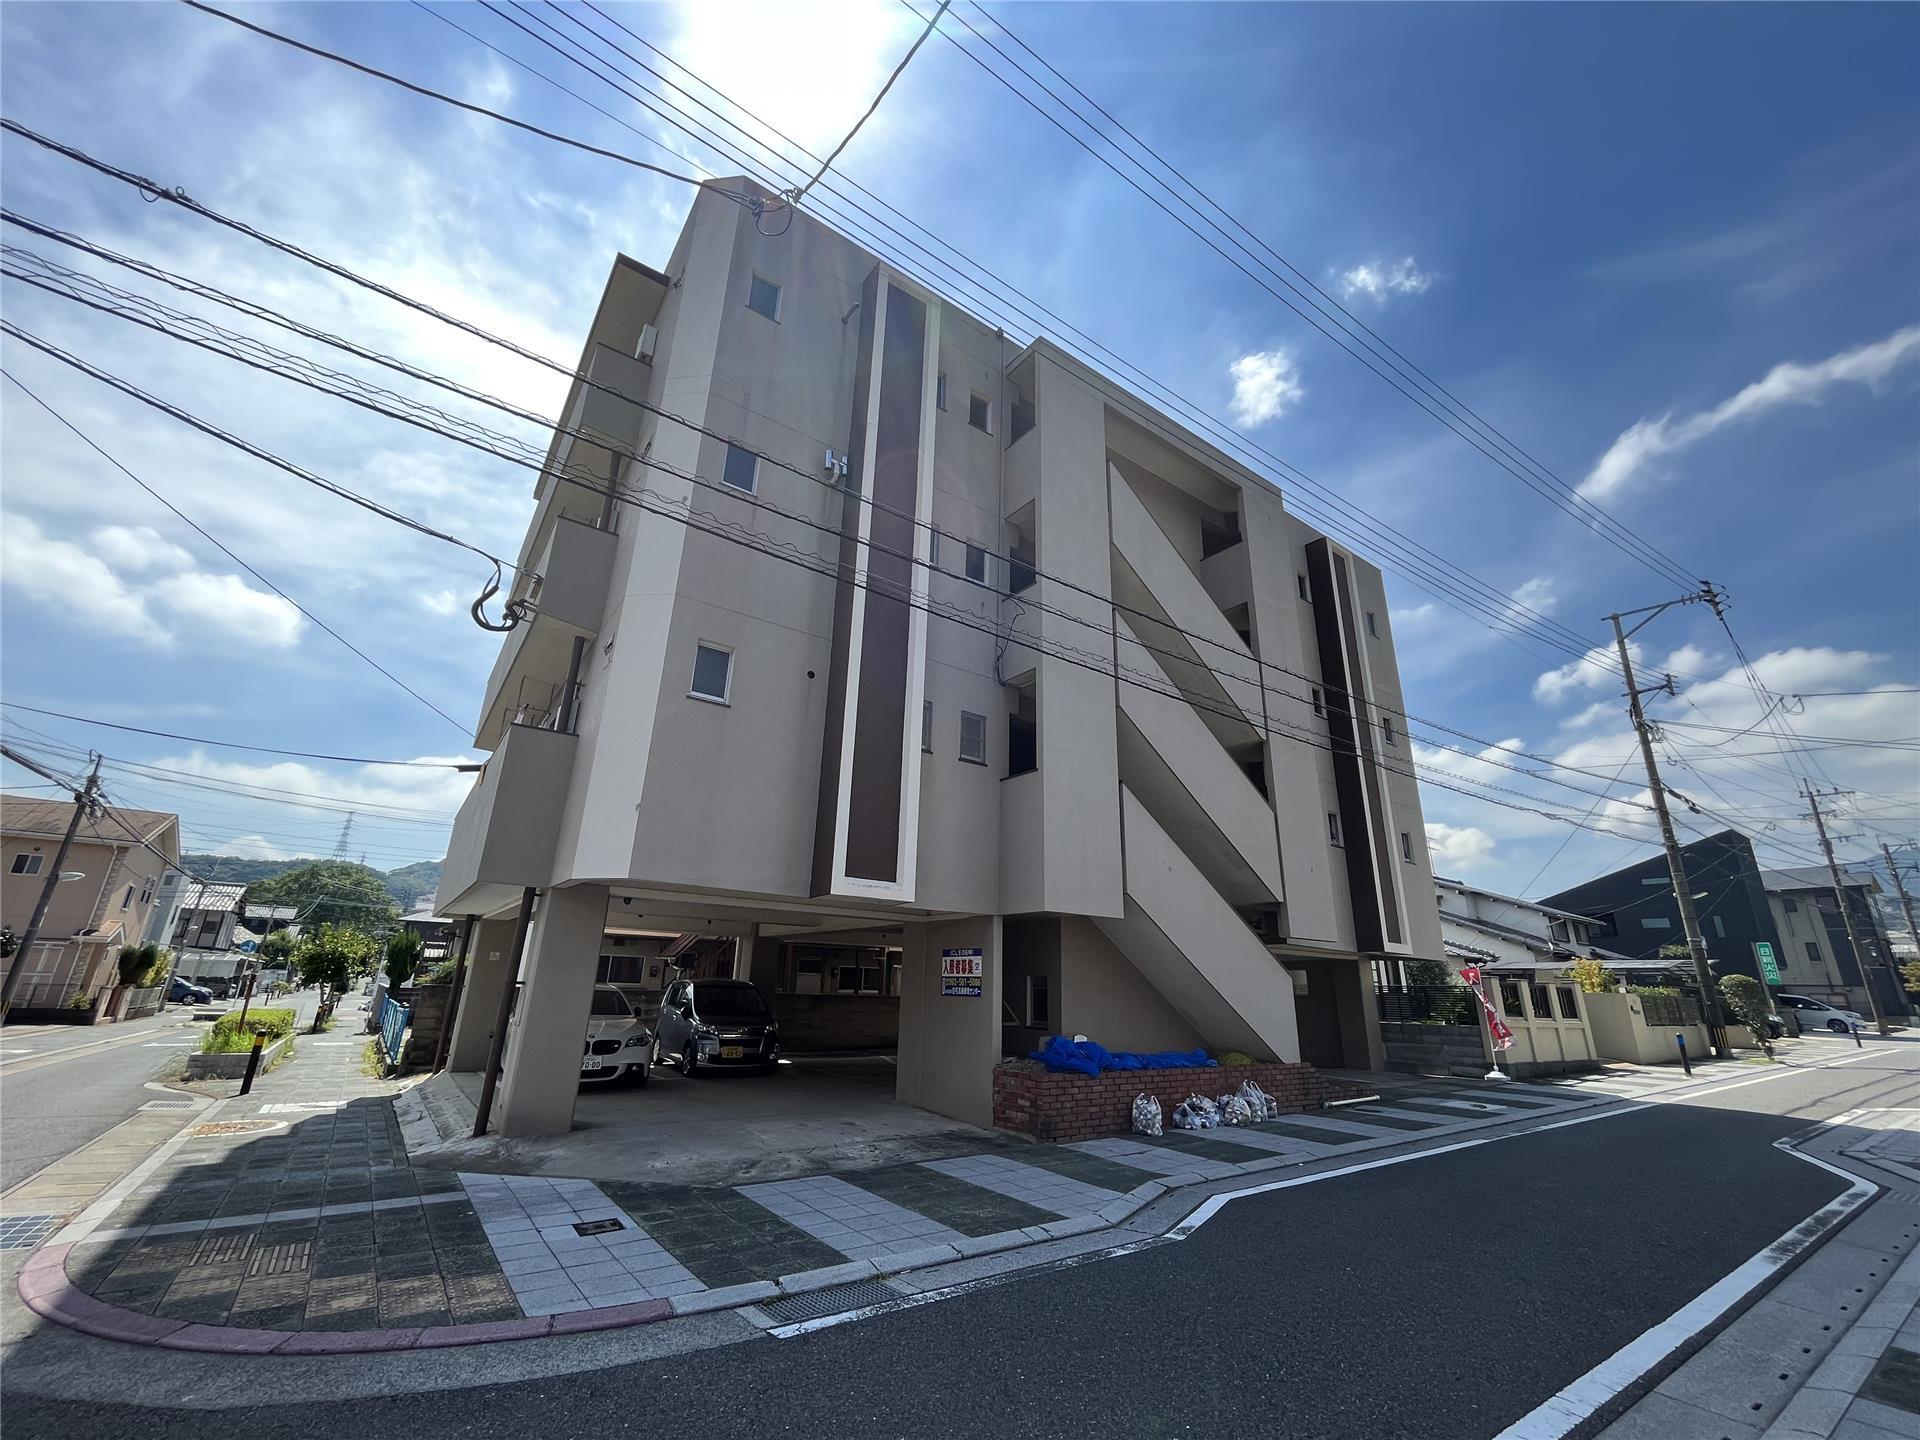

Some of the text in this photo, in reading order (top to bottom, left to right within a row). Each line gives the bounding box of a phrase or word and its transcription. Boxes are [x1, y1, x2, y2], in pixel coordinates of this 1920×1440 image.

[943, 959, 974, 975] 入居者募集
